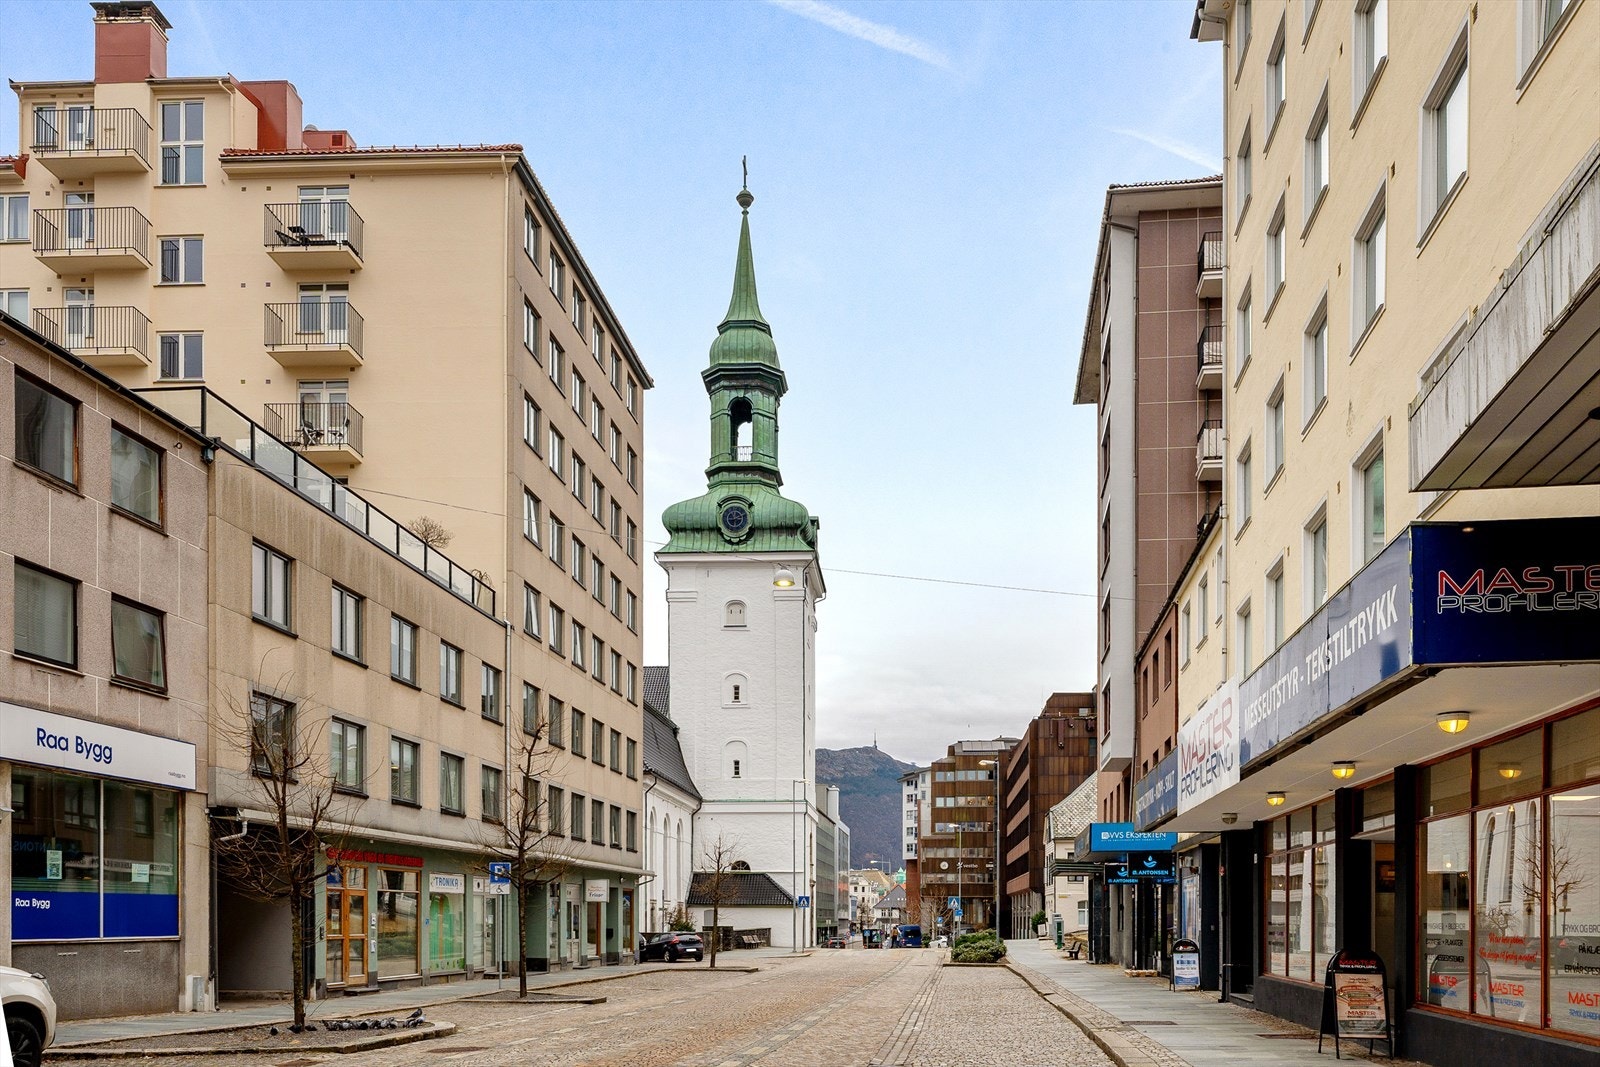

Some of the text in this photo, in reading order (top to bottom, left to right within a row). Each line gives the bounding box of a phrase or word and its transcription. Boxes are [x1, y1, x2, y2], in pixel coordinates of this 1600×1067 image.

[1437, 591, 1600, 614] PROFILER
[1244, 665, 1299, 734] MESSEUTSTYR
[1305, 584, 1398, 685] TEKSTILTRYKK
[36, 727, 112, 764] Raa Bygg
[1181, 697, 1232, 776] MASTER
[435, 877, 459, 887] TRONIKA
[15, 898, 51, 910] Raa Bygg
[1489, 982, 1524, 996] MASTER
